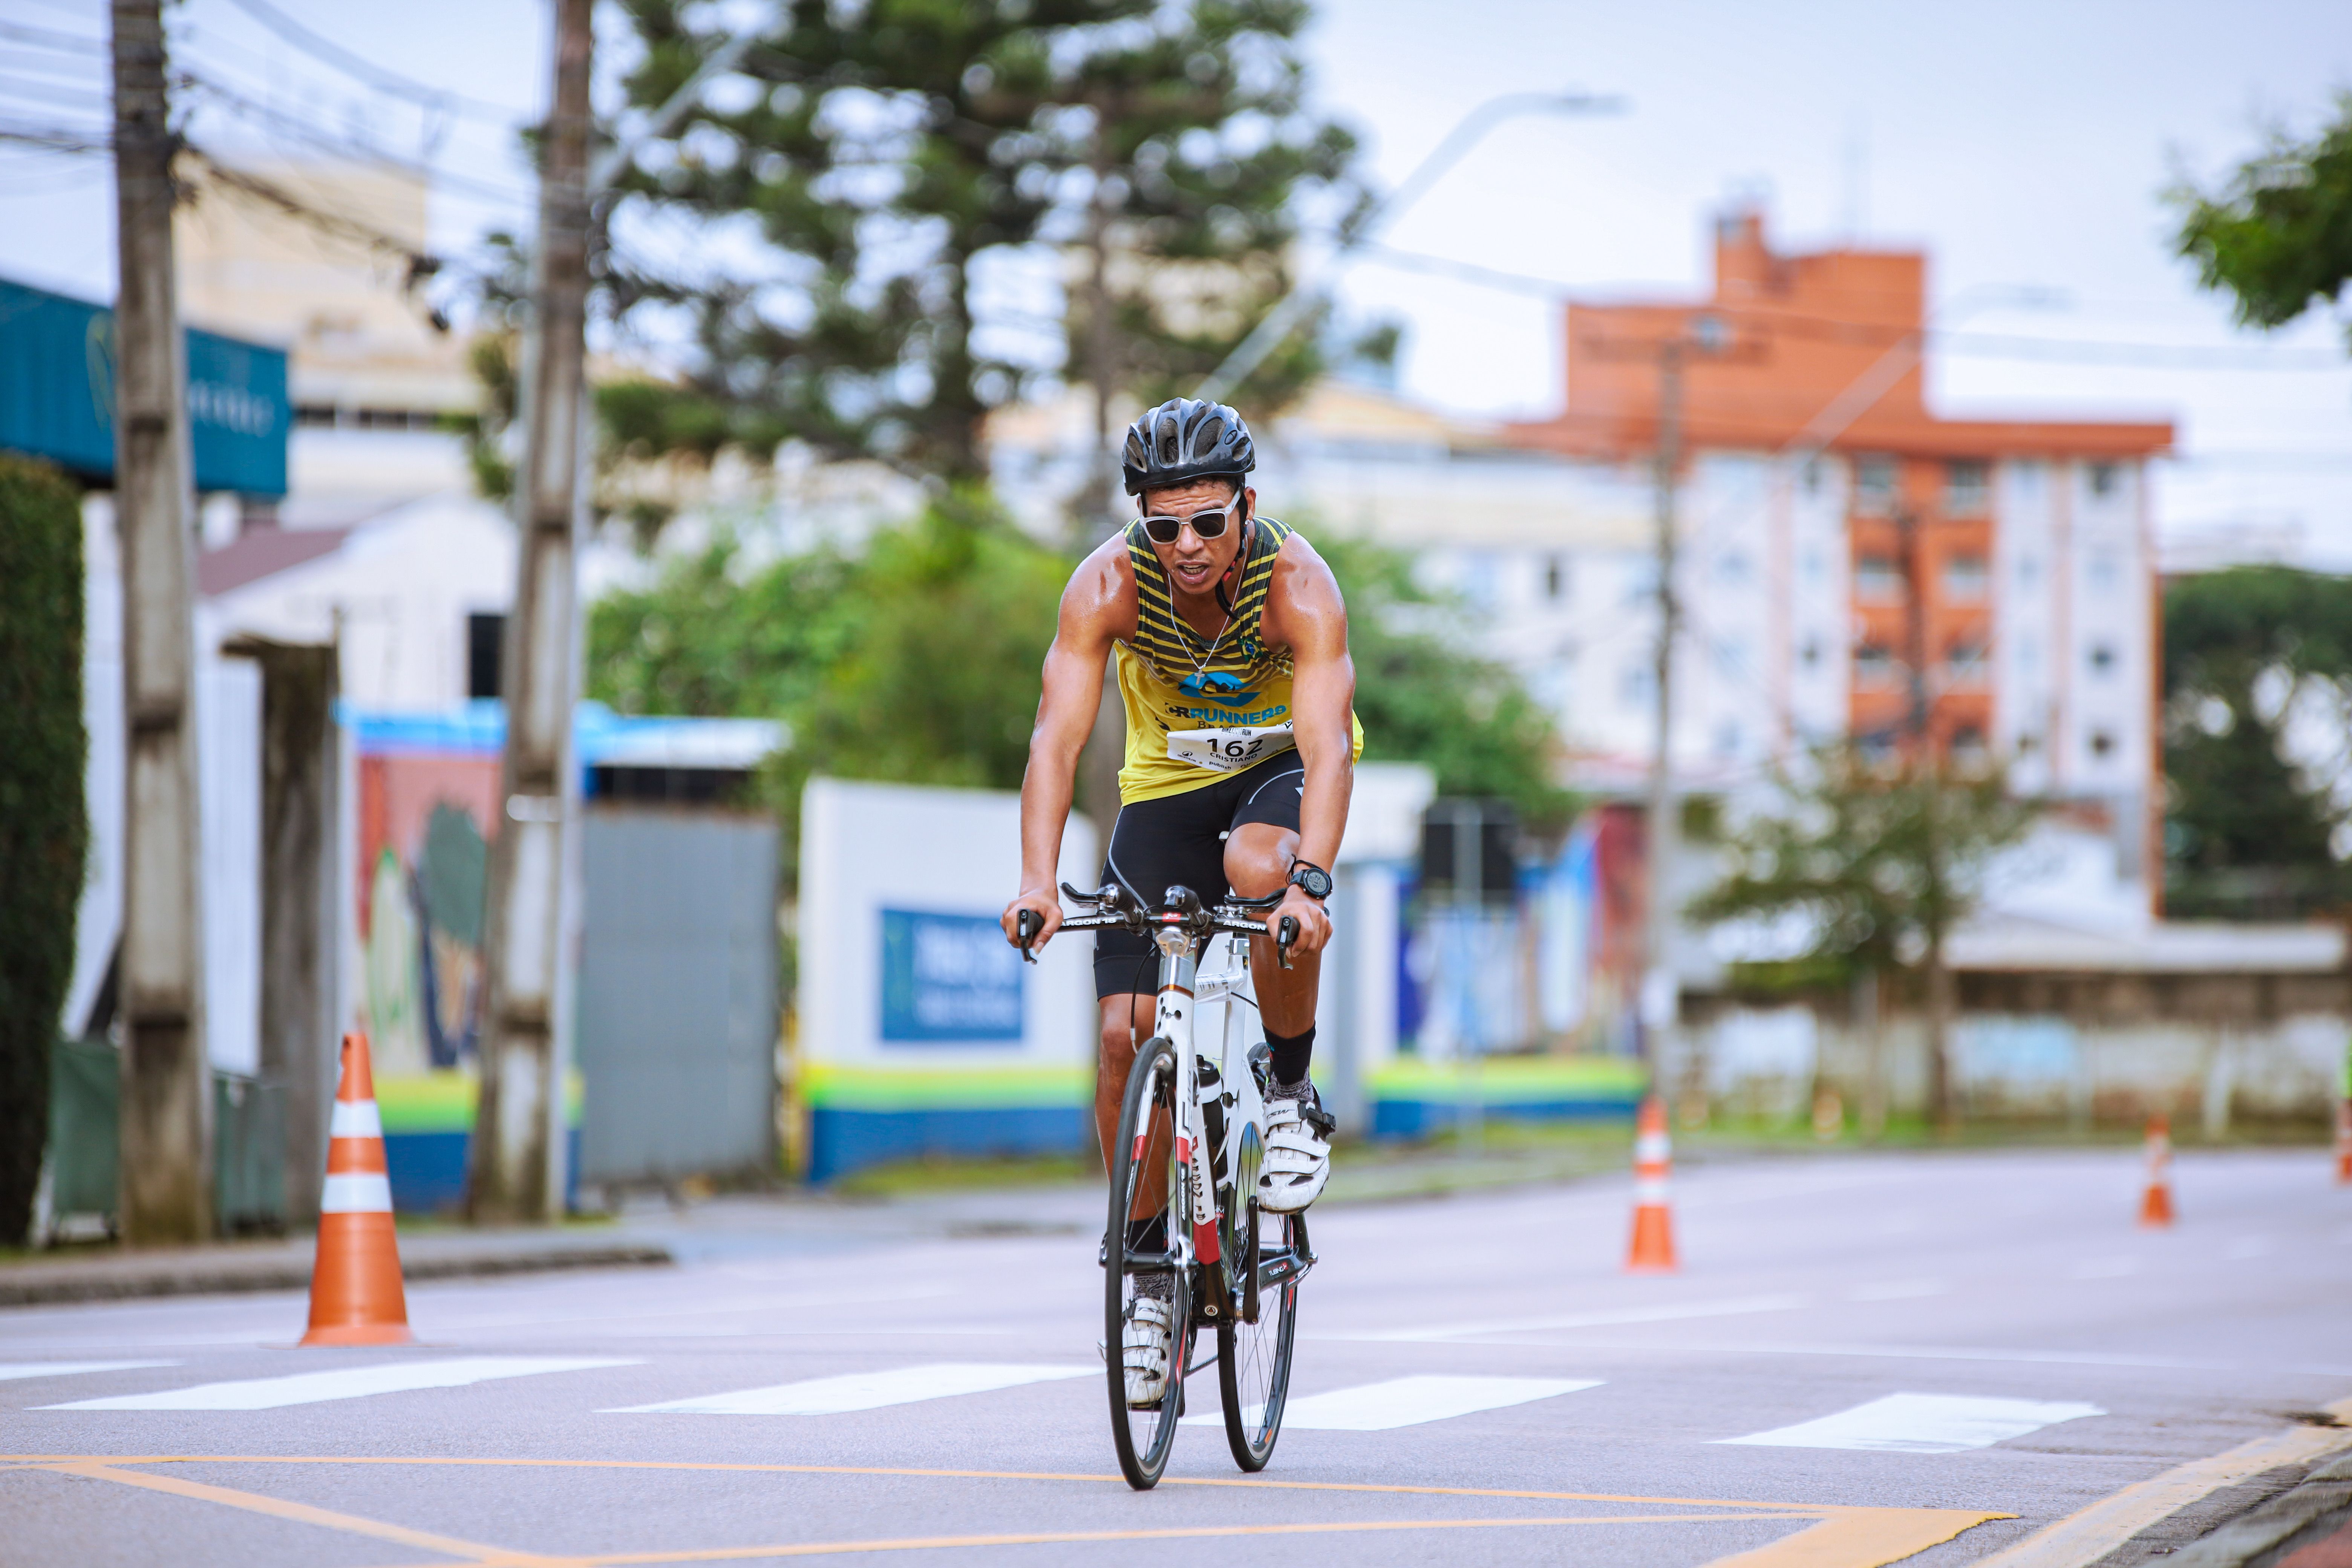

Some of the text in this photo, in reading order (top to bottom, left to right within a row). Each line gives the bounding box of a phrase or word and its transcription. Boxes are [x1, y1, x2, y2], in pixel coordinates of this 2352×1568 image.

[1207, 739, 1263, 757] 162
[1210, 752, 1257, 762] CRISTIANO
[1223, 920, 1267, 931] ARGON
